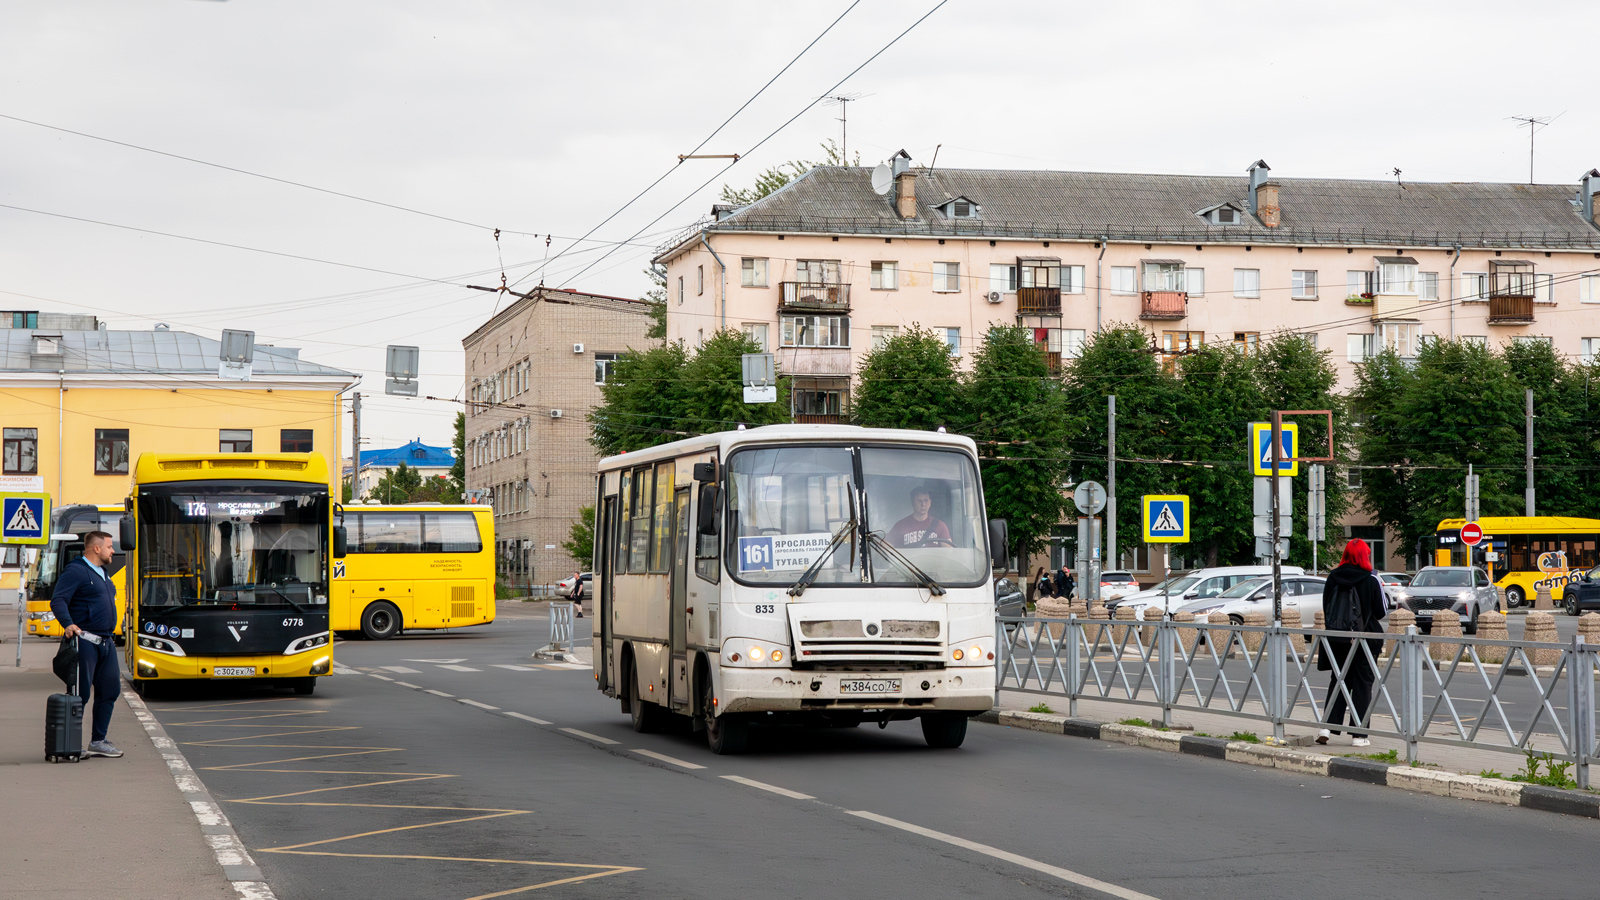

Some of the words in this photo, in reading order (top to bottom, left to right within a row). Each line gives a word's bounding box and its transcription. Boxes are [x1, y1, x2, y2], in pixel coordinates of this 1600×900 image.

[187, 502, 206, 516] 176
[775, 539, 830, 548] ЯРОСЛАВЛЬ
[743, 544, 769, 564] 161
[775, 558, 809, 566] ТУТАЕВ
[755, 605, 774, 613] 833
[282, 618, 304, 627] 6778
[844, 681, 885, 692] М384СО
